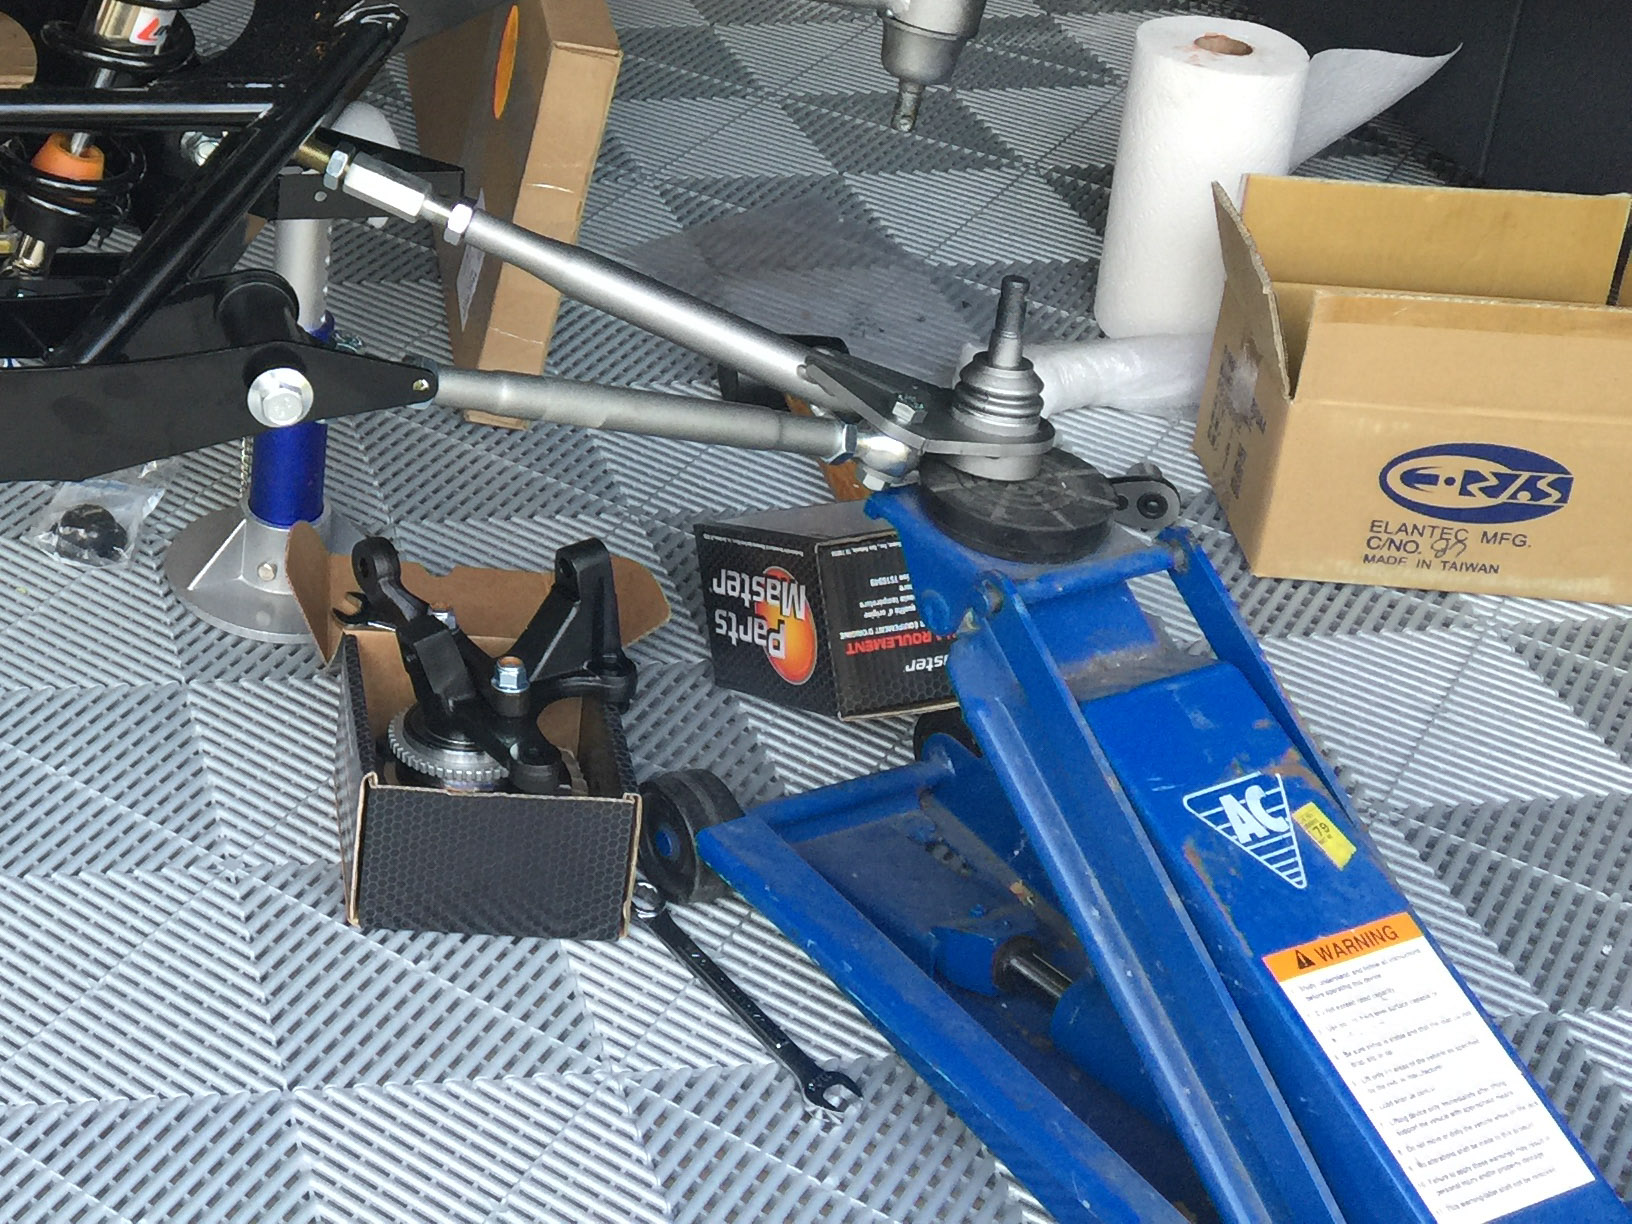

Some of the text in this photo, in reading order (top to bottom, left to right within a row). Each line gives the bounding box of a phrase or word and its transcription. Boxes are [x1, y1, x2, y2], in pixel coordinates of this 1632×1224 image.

[1366, 535, 1422, 555] C/NO.
[1369, 519, 1532, 548] ELANTEC MFG.
[1363, 554, 1500, 574] MADE IN TAIWAN
[711, 568, 806, 620] Master
[714, 608, 785, 660] Parts
[1219, 785, 1290, 844] AC
[1314, 925, 1399, 963] WARNING
